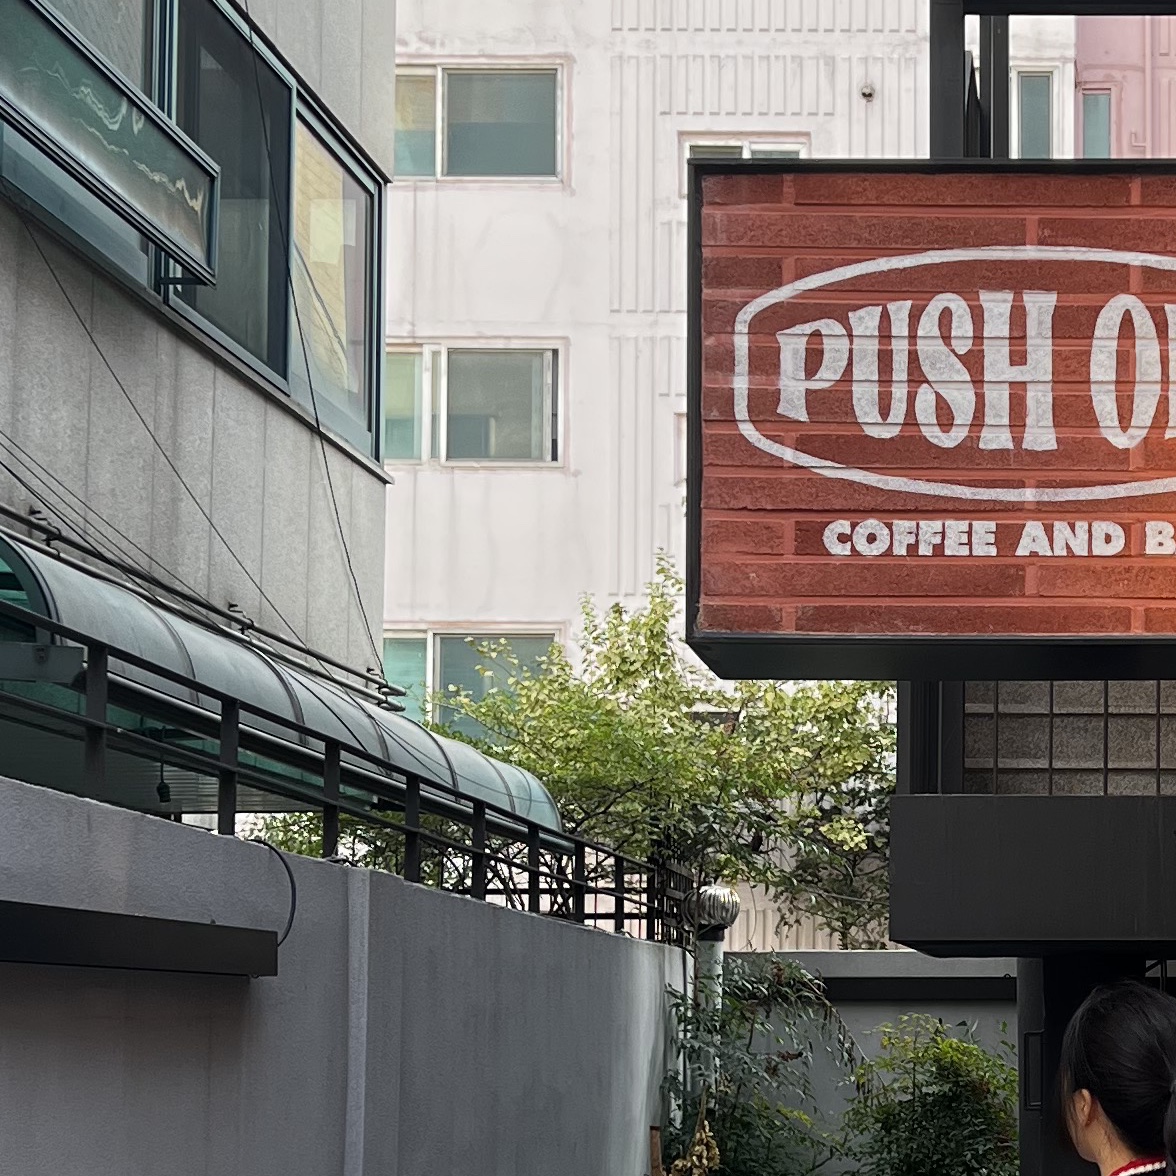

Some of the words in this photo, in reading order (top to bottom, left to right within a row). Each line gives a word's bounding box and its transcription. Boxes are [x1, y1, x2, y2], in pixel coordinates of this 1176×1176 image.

[775, 289, 1058, 452] PUSH
[821, 517, 1002, 557] COFFEE
[1014, 520, 1126, 557] AND
